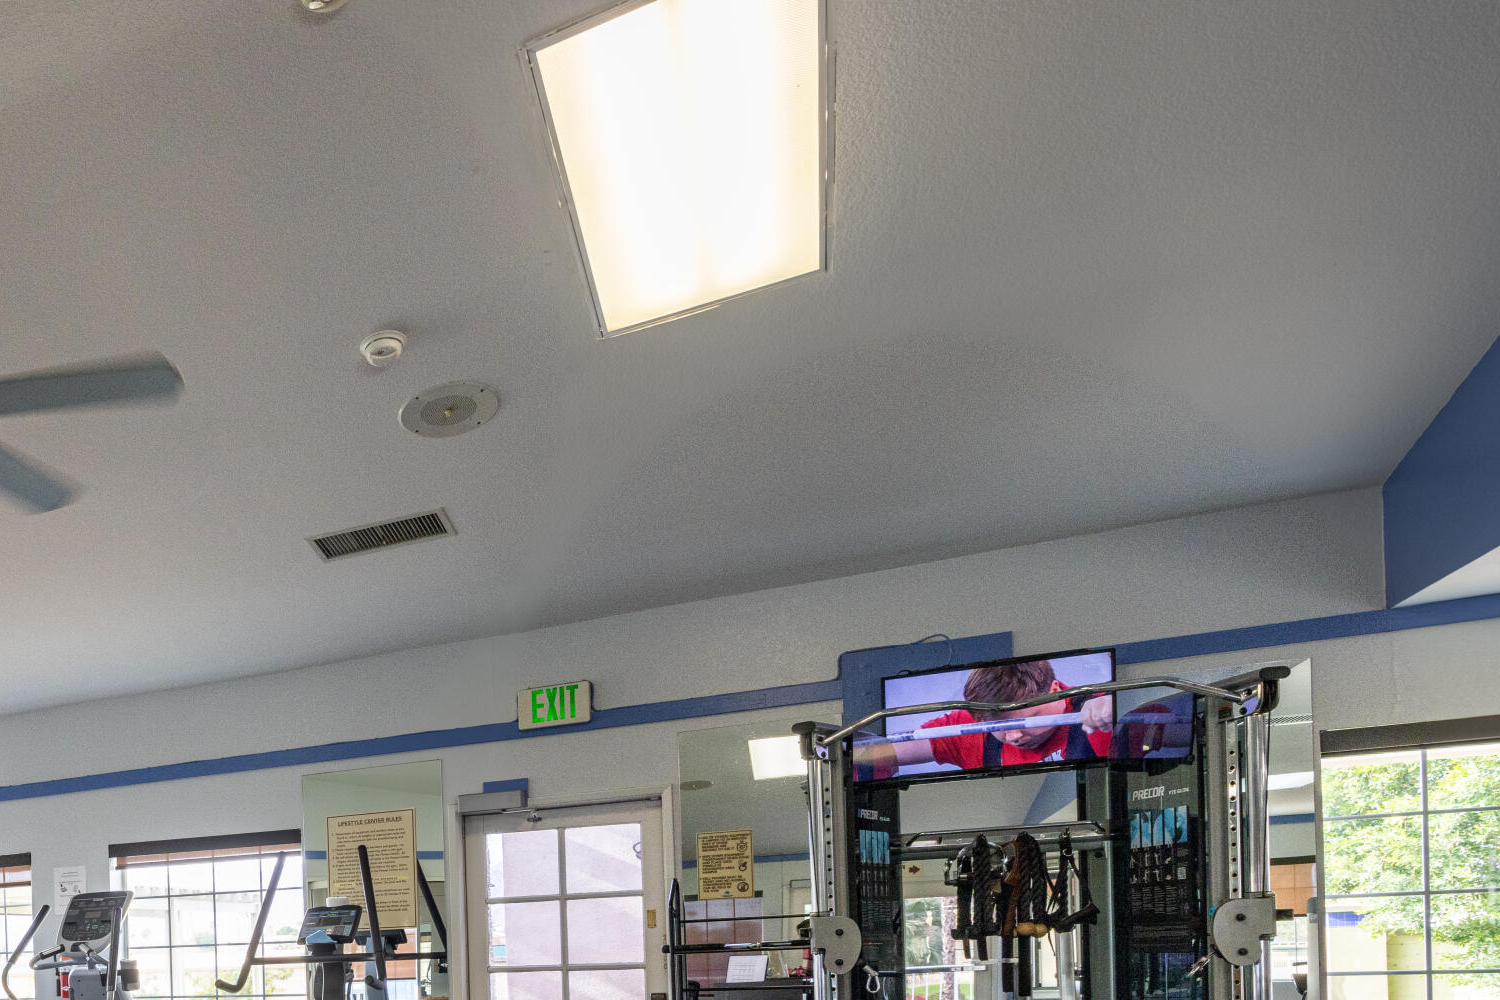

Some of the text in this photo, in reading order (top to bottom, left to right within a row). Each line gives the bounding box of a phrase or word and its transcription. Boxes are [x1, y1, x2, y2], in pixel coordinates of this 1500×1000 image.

[531, 684, 579, 724] EXIT
[1132, 786, 1165, 801] PRECOR
[364, 817, 385, 825] CENTER
